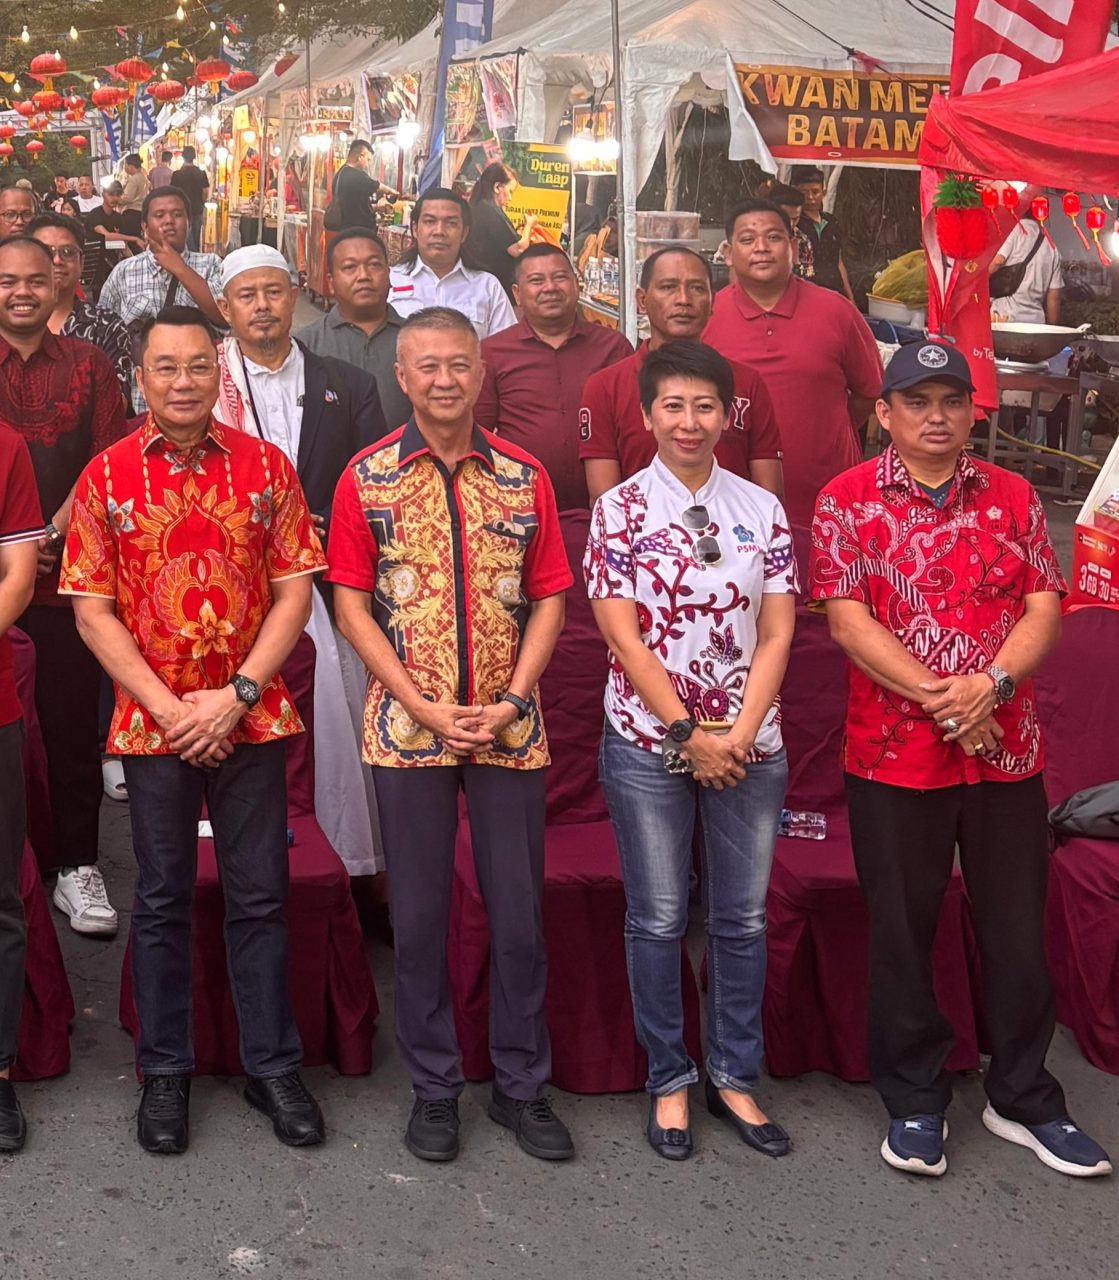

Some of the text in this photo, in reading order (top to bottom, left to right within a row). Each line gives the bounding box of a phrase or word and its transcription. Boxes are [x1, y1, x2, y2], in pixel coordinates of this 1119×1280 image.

[786, 113, 926, 153] BATAM
[530, 158, 570, 174] Duren
[537, 171, 569, 188] kaap
[1079, 564, 1088, 592] 3
[1086, 574, 1098, 596] GB
[1098, 579, 1110, 602] 30
